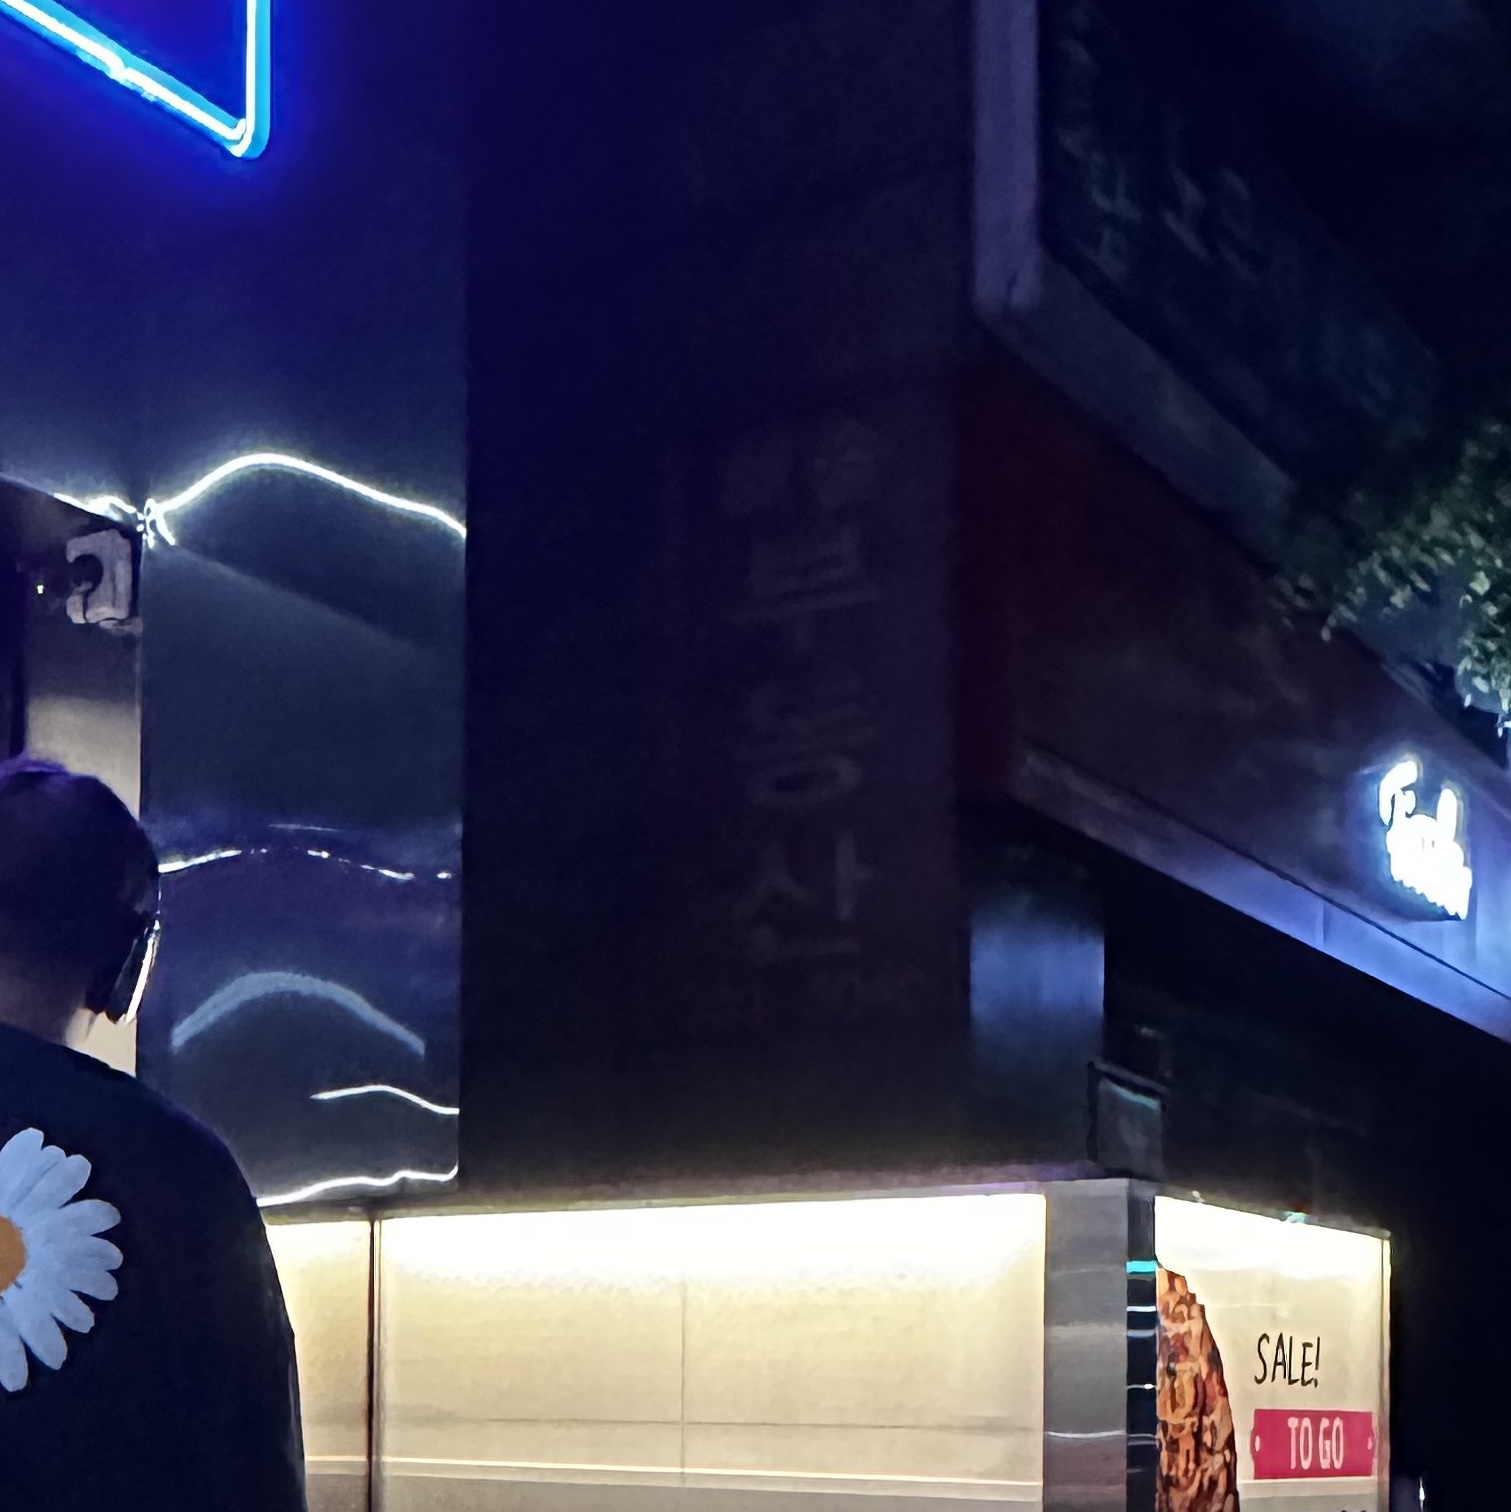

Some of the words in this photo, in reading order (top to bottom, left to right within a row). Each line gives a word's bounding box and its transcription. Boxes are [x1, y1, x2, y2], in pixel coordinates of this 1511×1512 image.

[1254, 1332, 1320, 1388] SALE!
[1288, 1417, 1312, 1470] TO
[1319, 1417, 1344, 1470] GO
